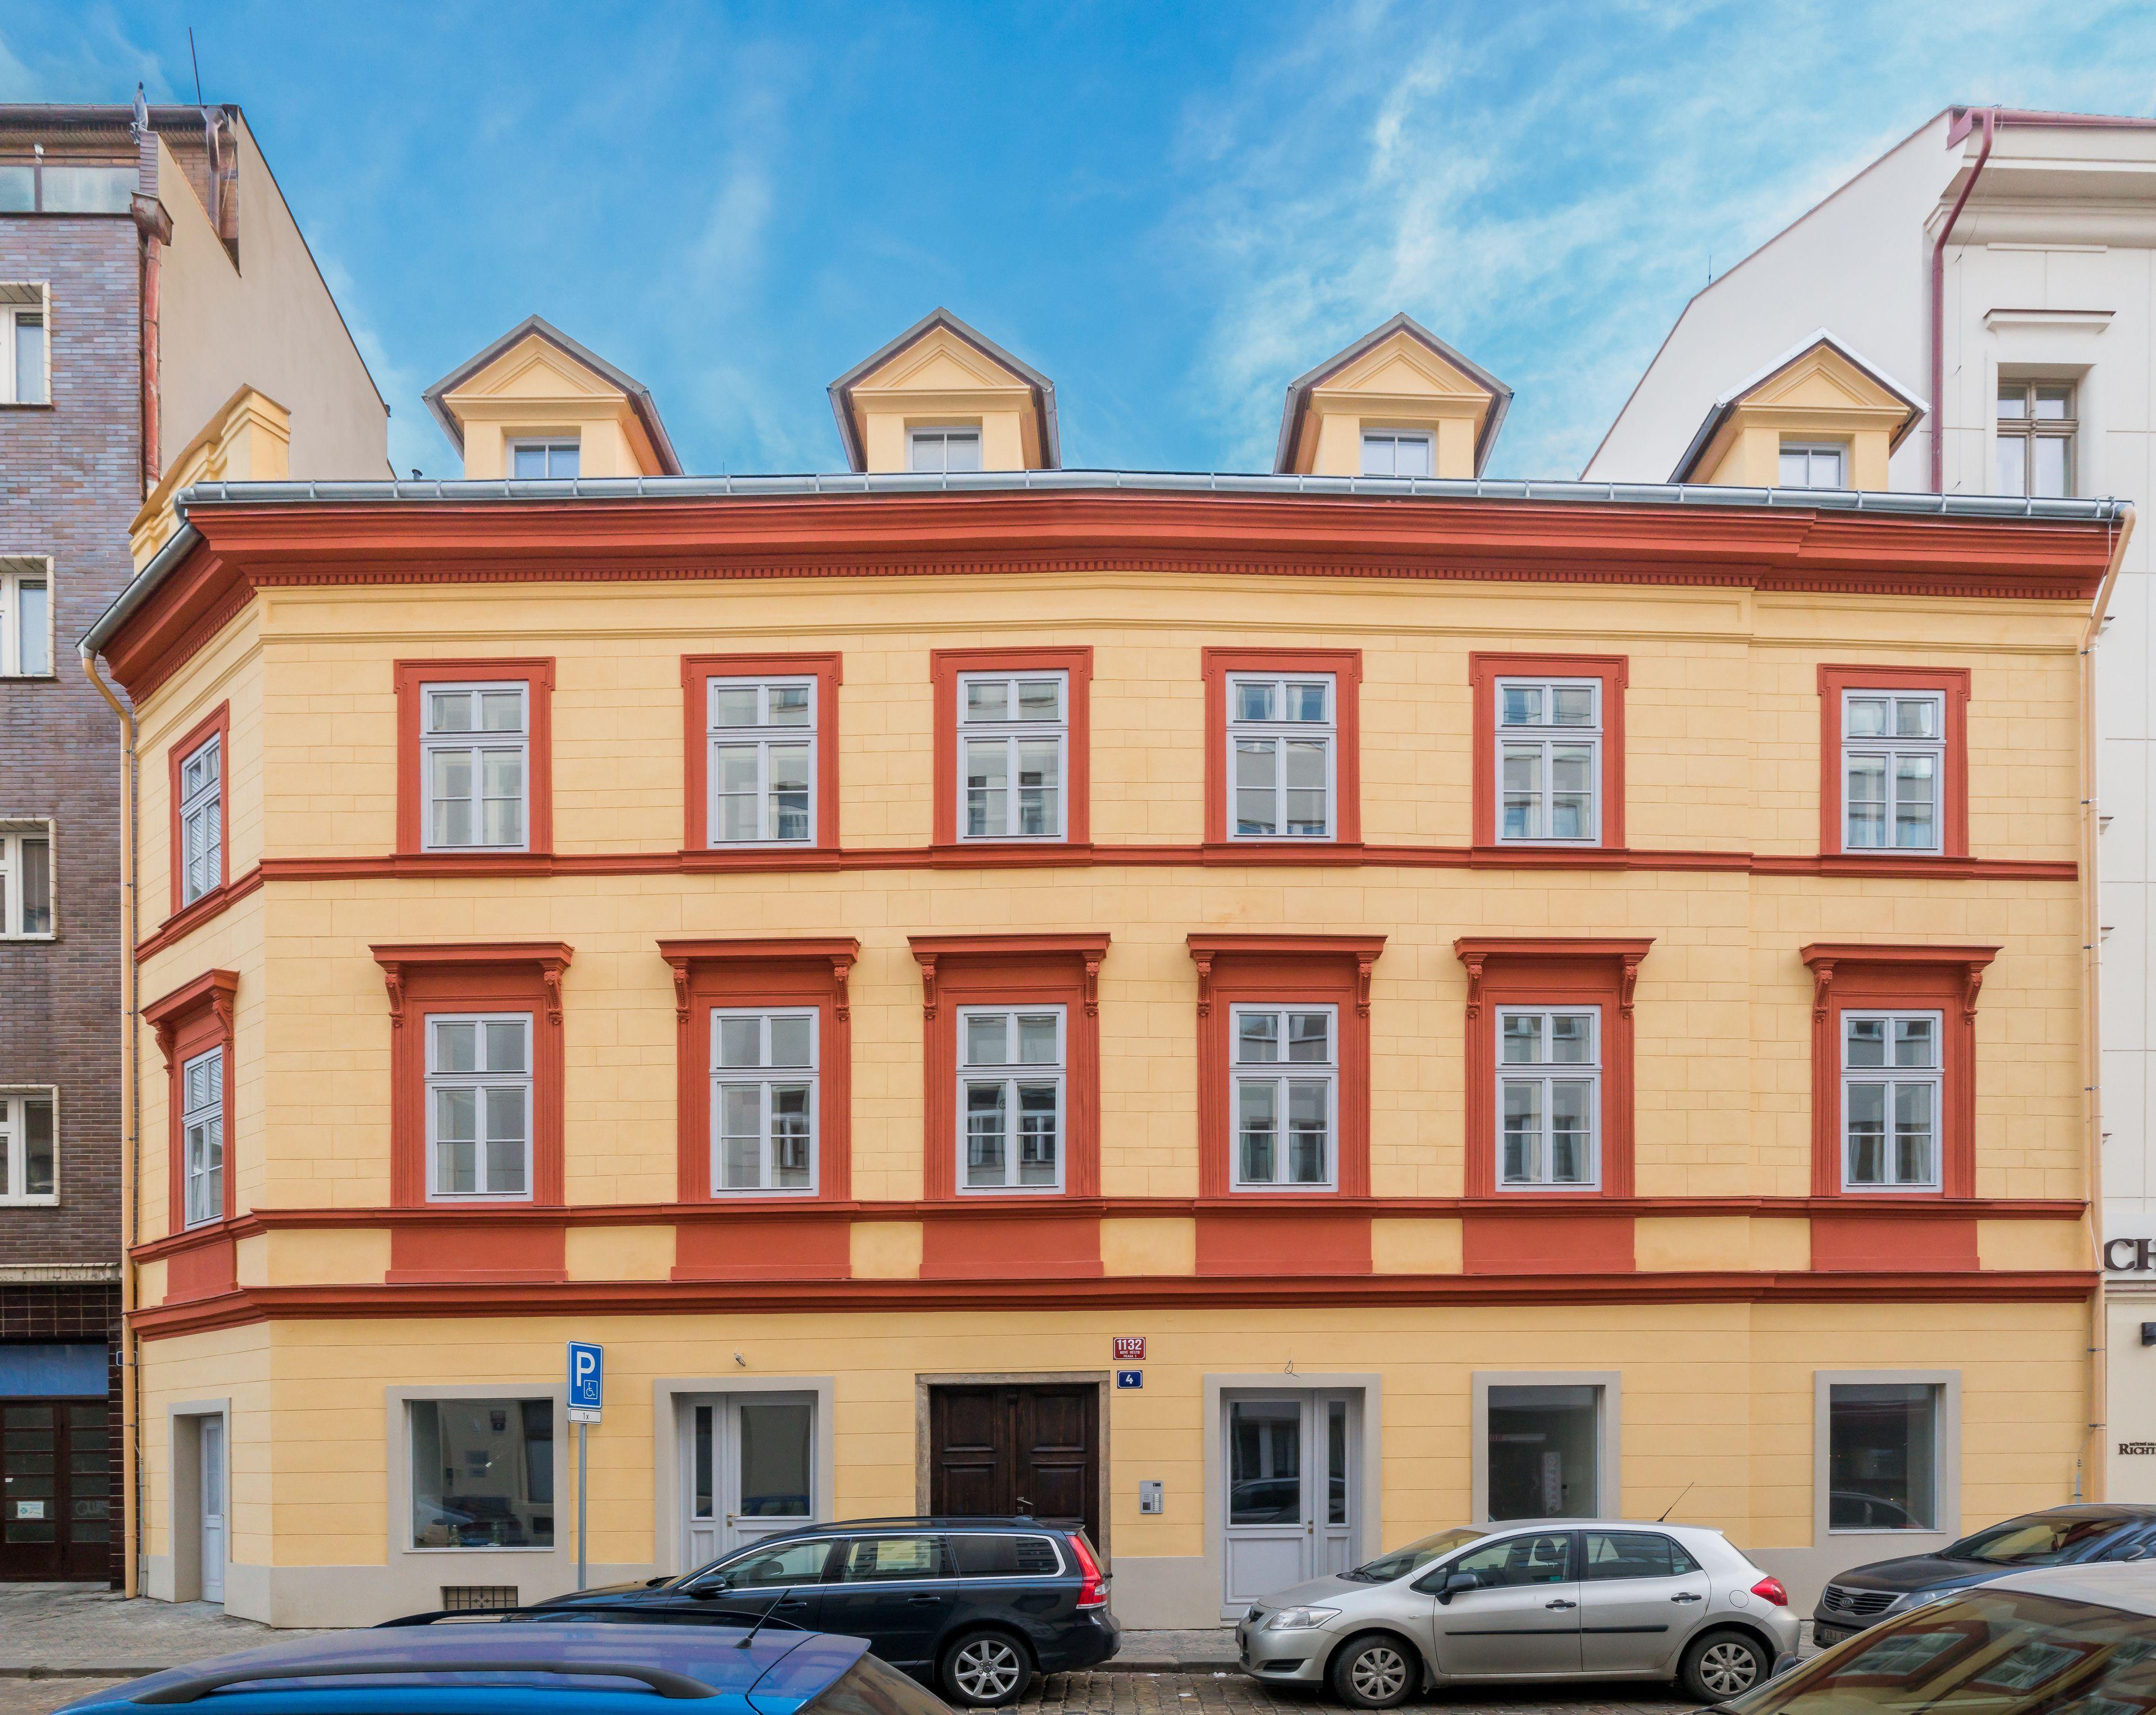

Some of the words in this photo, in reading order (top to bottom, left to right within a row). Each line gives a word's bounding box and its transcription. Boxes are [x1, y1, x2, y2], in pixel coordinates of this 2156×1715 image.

[1117, 1339, 1141, 1350] 1132
[577, 1351, 595, 1386] P
[1126, 1374, 1134, 1384] 4
[2118, 1443, 2156, 1455] RICHT
